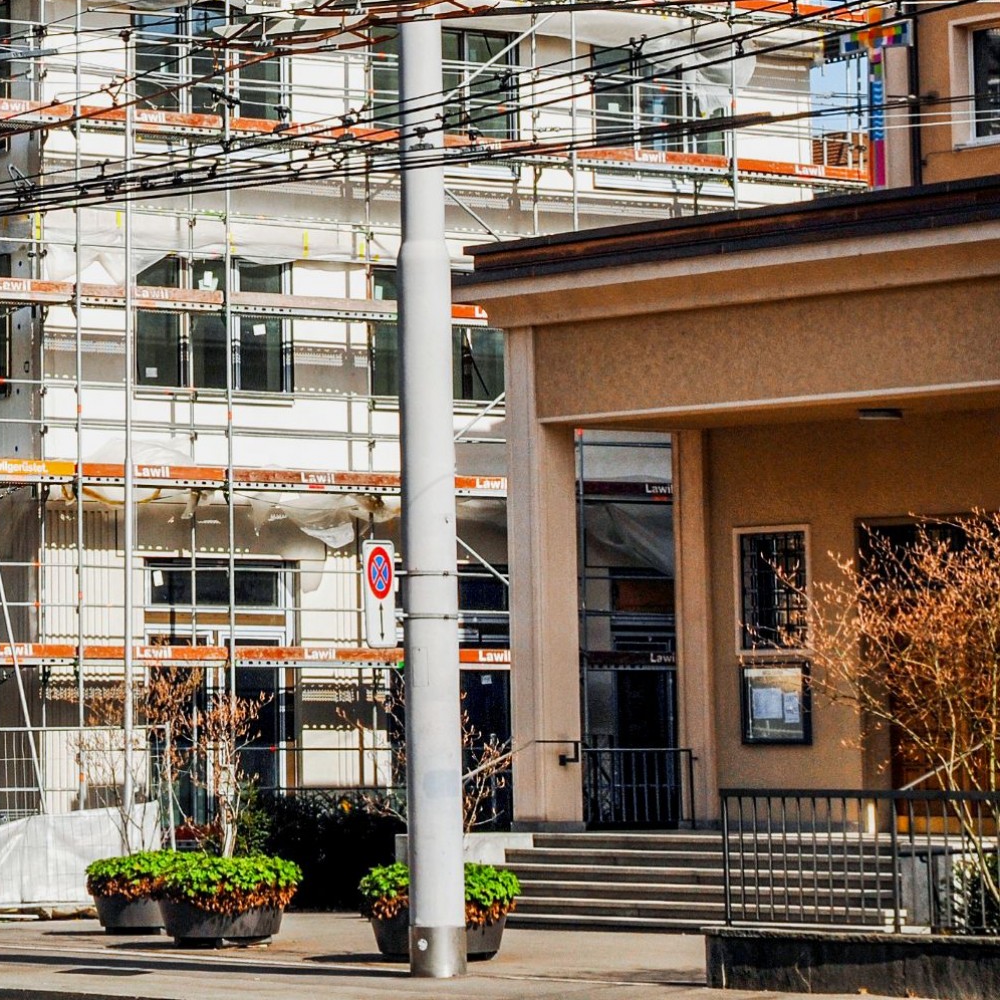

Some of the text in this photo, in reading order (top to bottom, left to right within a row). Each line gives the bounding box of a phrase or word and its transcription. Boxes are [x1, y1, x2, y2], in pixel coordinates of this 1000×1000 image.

[634, 149, 667, 164] Lawil
[795, 164, 826, 178] Lawil
[134, 287, 170, 301] Lawil
[134, 464, 170, 479] Lawil
[301, 471, 335, 486] Lawil
[136, 645, 172, 659] Lawil
[304, 648, 337, 662] Lawil
[478, 649, 511, 663] Lawil
[650, 652, 675, 664] Lawi
